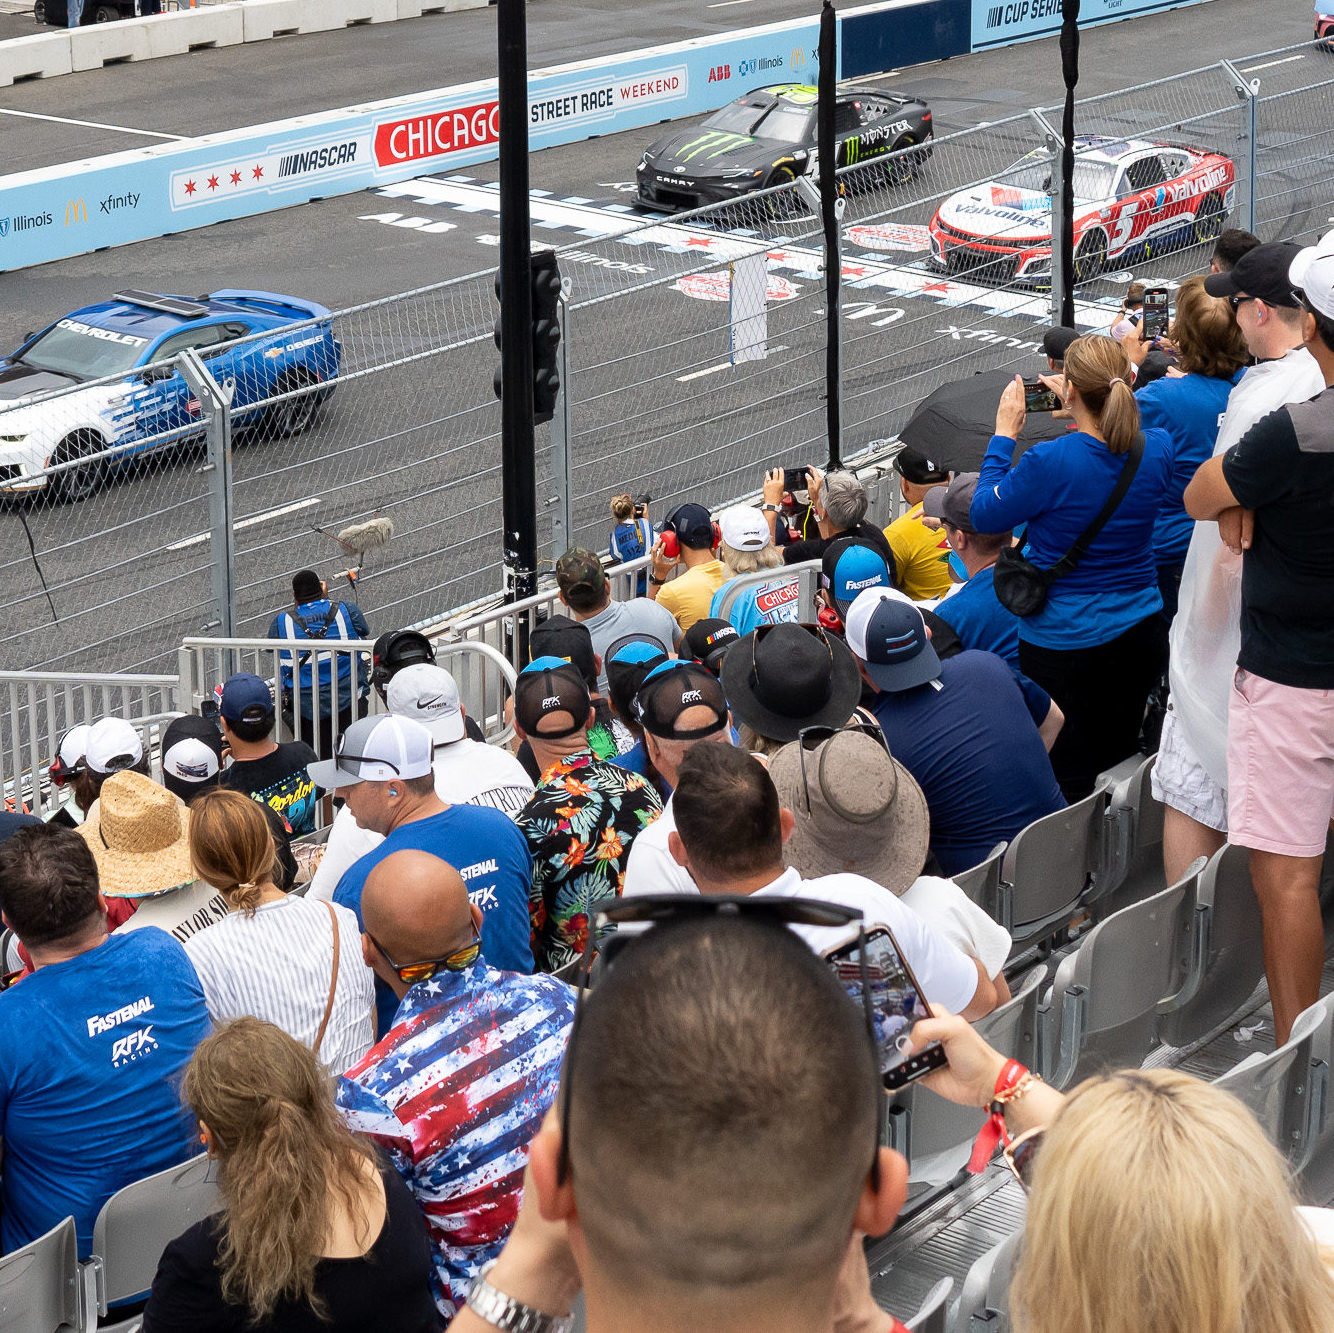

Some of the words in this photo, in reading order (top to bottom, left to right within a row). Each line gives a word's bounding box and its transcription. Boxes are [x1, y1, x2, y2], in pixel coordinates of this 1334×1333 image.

[1004, 1, 1029, 25] CUP
[1108, 0, 1124, 9] LIGHT
[708, 65, 731, 83] ABB
[758, 55, 784, 71] Illinois
[298, 141, 357, 174] NASCAR
[531, 95, 578, 123] STREET
[581, 87, 614, 112] RACE
[619, 76, 680, 100] WEEKEND
[860, 118, 913, 145] MONSTER
[860, 144, 892, 158] ENERGY
[1075, 161, 1106, 170] ARSON
[1167, 165, 1229, 203] Valvoline
[13, 210, 53, 232] Illinois
[99, 192, 141, 215] xfinity
[955, 203, 1047, 229] Valvoline
[1112, 202, 1139, 249] 5
[56, 318, 149, 348] CHEVROLET
[845, 574, 882, 590] FASTENAL
[459, 858, 499, 882] STENAL
[171, 907, 214, 944] AYLOR
[86, 996, 155, 1037] FASTENAL
[112, 1025, 156, 1061] RFK
[113, 1043, 159, 1068] RACING
